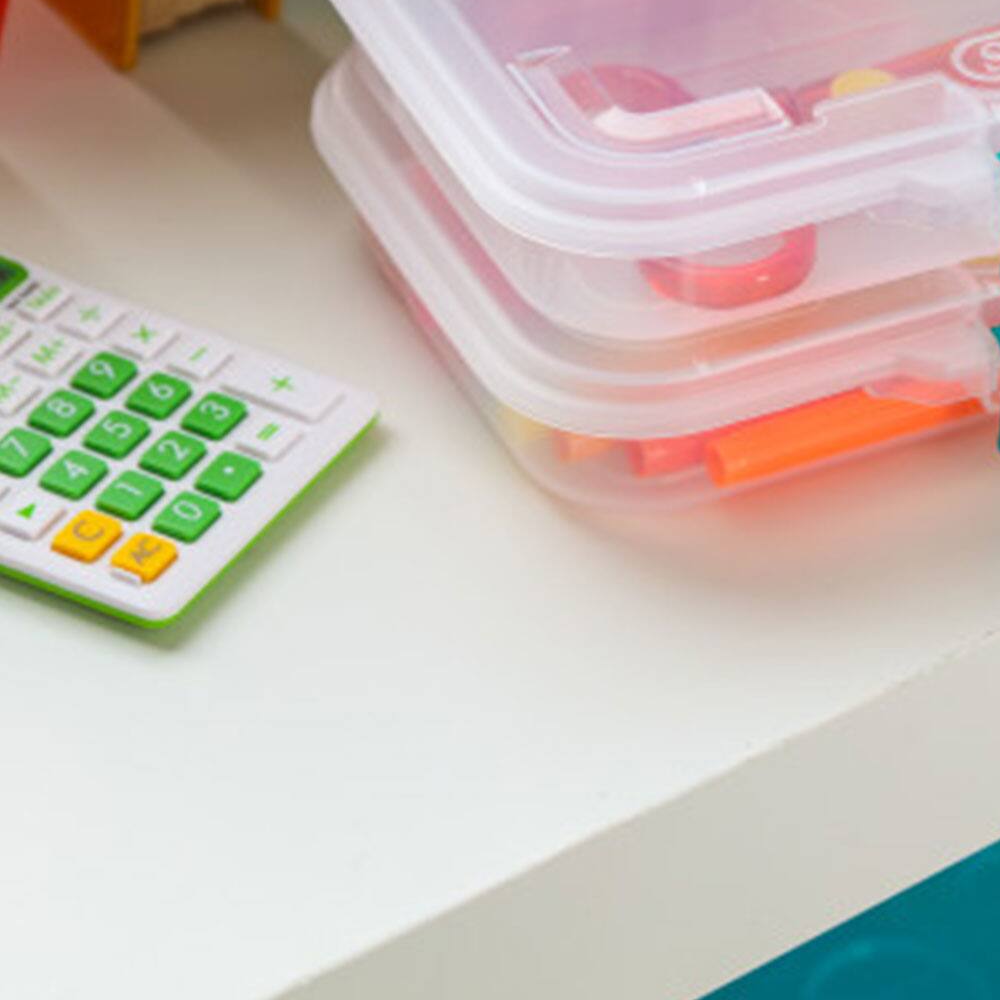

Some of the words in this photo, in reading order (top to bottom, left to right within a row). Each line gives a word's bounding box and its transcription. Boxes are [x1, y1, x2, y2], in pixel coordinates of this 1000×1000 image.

[2, 437, 28, 458] 7
[47, 400, 76, 418] 8
[90, 361, 115, 380] 9
[62, 461, 89, 480] 4
[103, 421, 132, 440] 5
[150, 381, 174, 400] 6
[73, 519, 105, 542] C
[116, 484, 142, 497] 1
[159, 440, 190, 461] 2
[201, 402, 229, 421] 3
[129, 540, 160, 563] AC
[172, 502, 202, 521] 0
